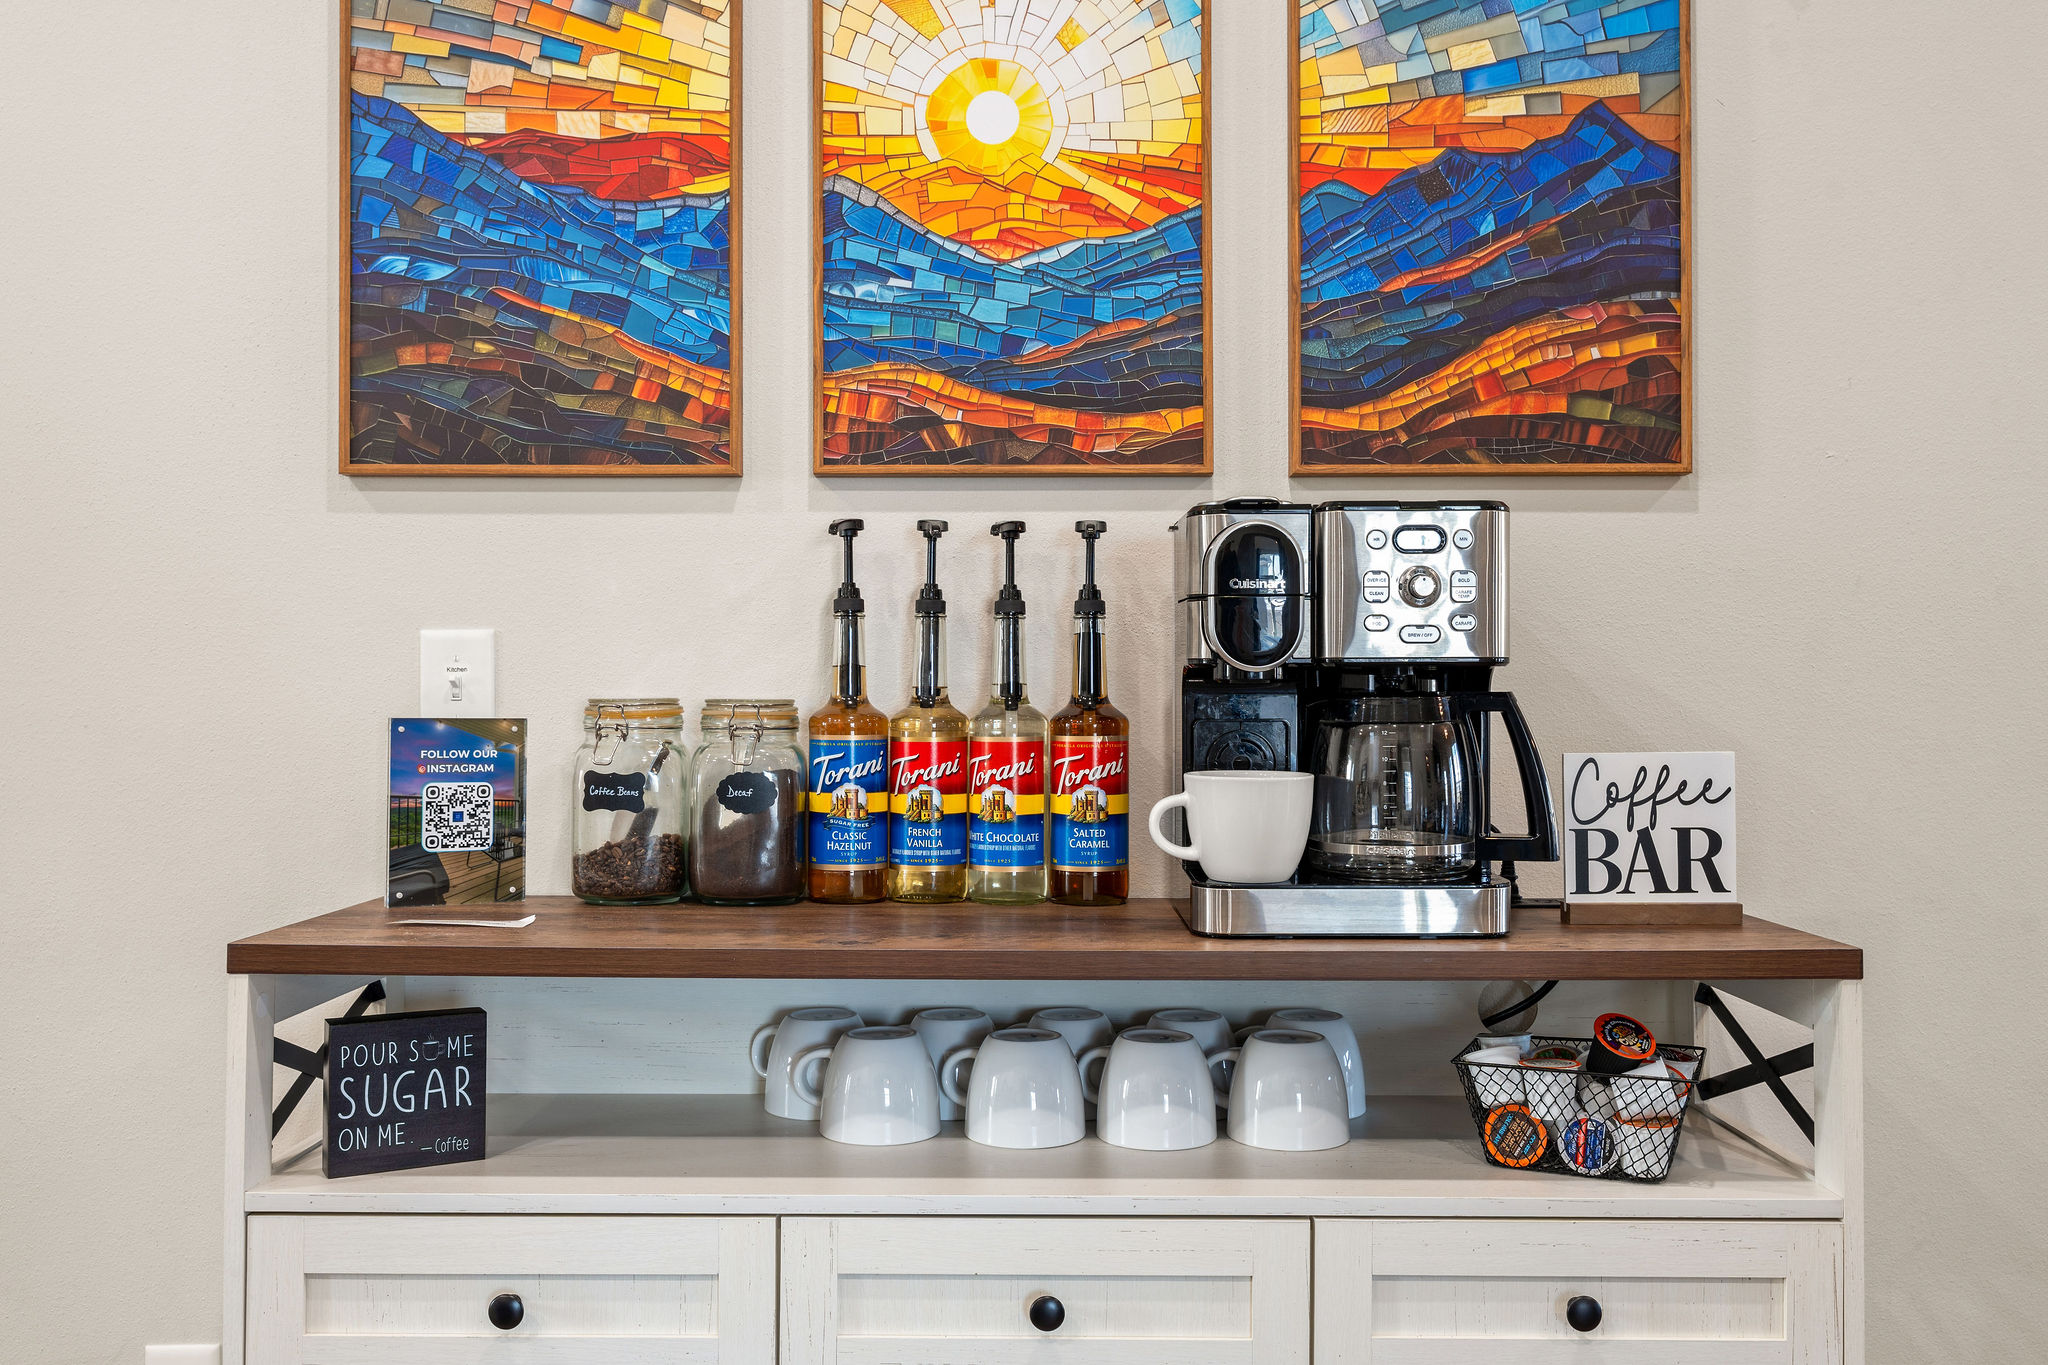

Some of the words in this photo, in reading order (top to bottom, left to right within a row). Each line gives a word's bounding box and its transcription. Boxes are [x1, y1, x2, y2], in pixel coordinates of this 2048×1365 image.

[1228, 578, 1286, 590] Cuisinart
[420, 750, 470, 759] FOLLOW
[472, 750, 498, 758] OUR
[426, 764, 494, 773] INSTAGRAM
[813, 750, 884, 796] Torani
[892, 752, 960, 796] Torani
[970, 752, 1035, 796] Torani
[1054, 752, 1124, 797] Torani
[589, 784, 616, 796] Coffee
[616, 786, 639, 797] Beans
[726, 784, 754, 798] Decaf
[1571, 757, 1732, 832] Coffee
[832, 831, 867, 841] CLASSIC
[908, 827, 942, 836] FRENCH
[986, 832, 1040, 842] CHOCOLATE
[1074, 828, 1106, 838] SALTED
[827, 841, 872, 850] HAZELNUT
[906, 838, 943, 848] VANILLA
[1069, 839, 1110, 848] CARAMEL
[1568, 826, 1732, 894] BAR
[341, 1042, 399, 1068] POUR
[338, 1066, 472, 1120] SUGAR
[338, 1126, 367, 1152] ON
[378, 1122, 414, 1147] ME.
